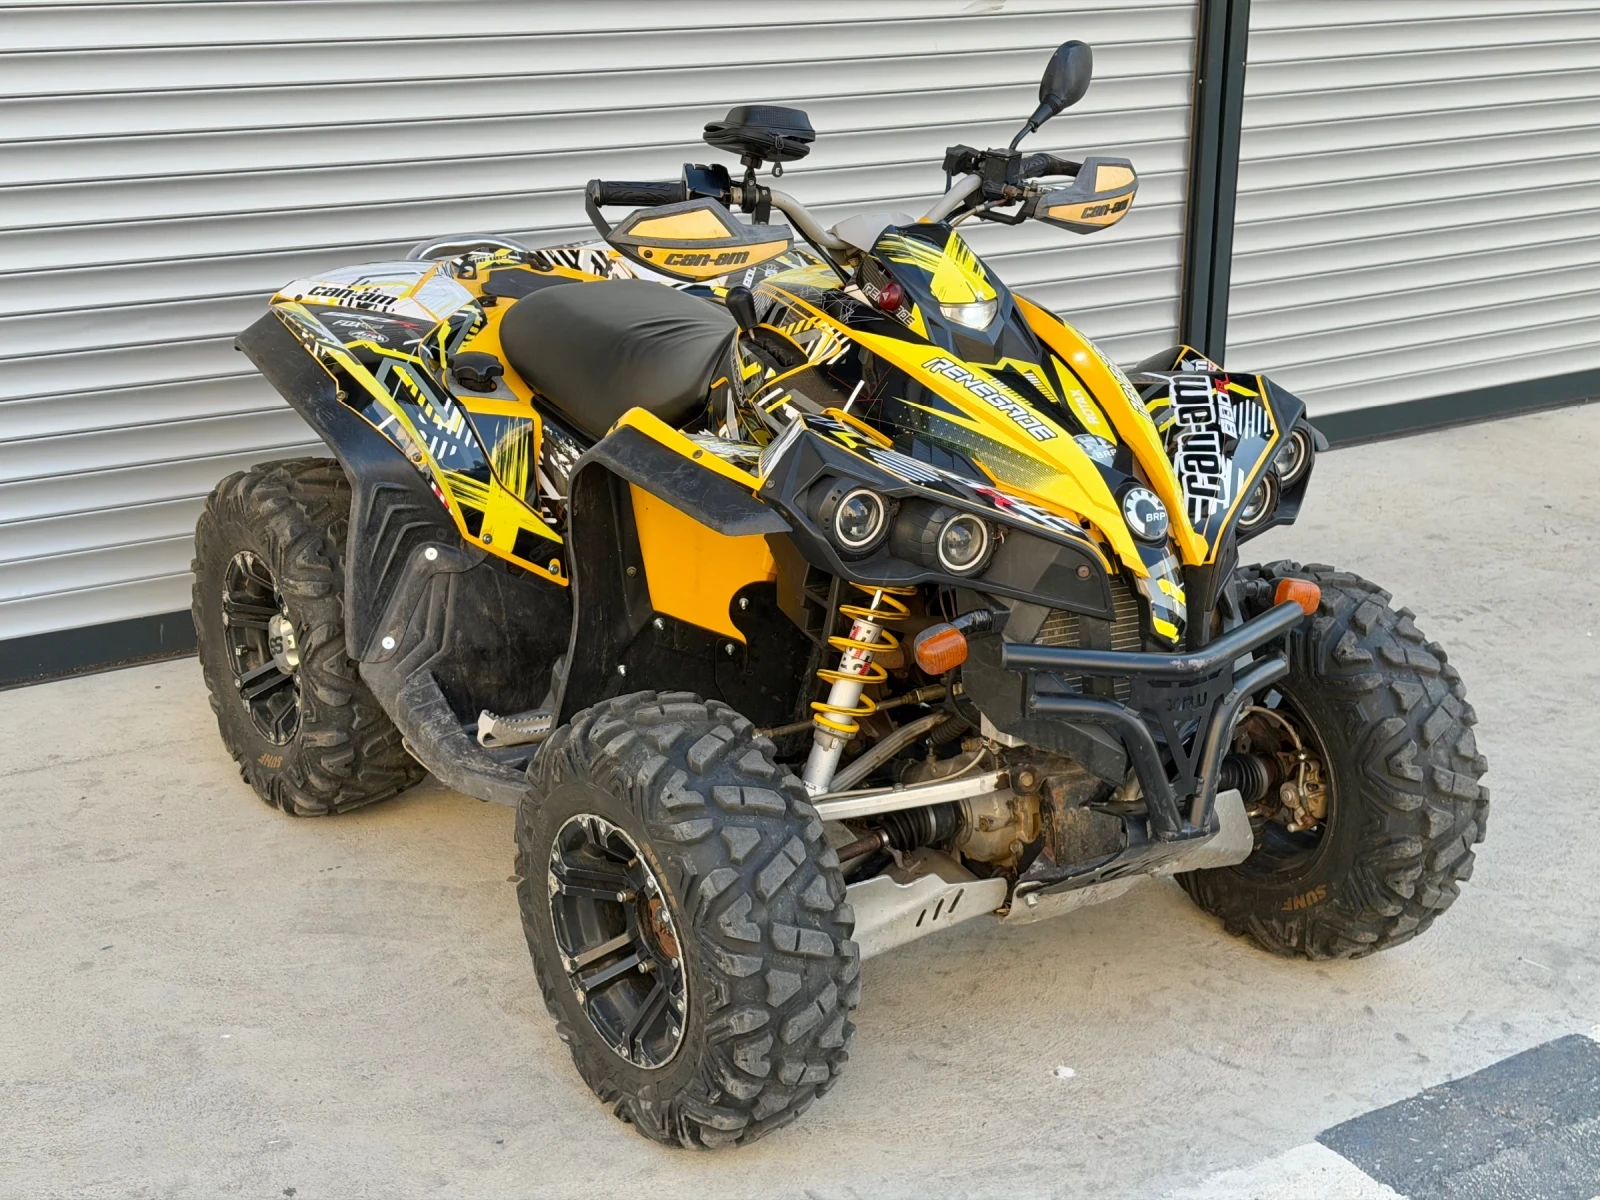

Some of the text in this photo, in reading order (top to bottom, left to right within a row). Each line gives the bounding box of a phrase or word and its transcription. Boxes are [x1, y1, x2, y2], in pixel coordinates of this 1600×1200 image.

[664, 251, 750, 267] can-am
[307, 285, 399, 306] can-am
[921, 357, 1058, 442] RENEGADE
[1068, 388, 1101, 425] ROTAX
[1169, 374, 1222, 500] can-am
[1095, 448, 1117, 459] BRP
[1145, 512, 1166, 522] BRP
[1281, 884, 1328, 911] SUNF
